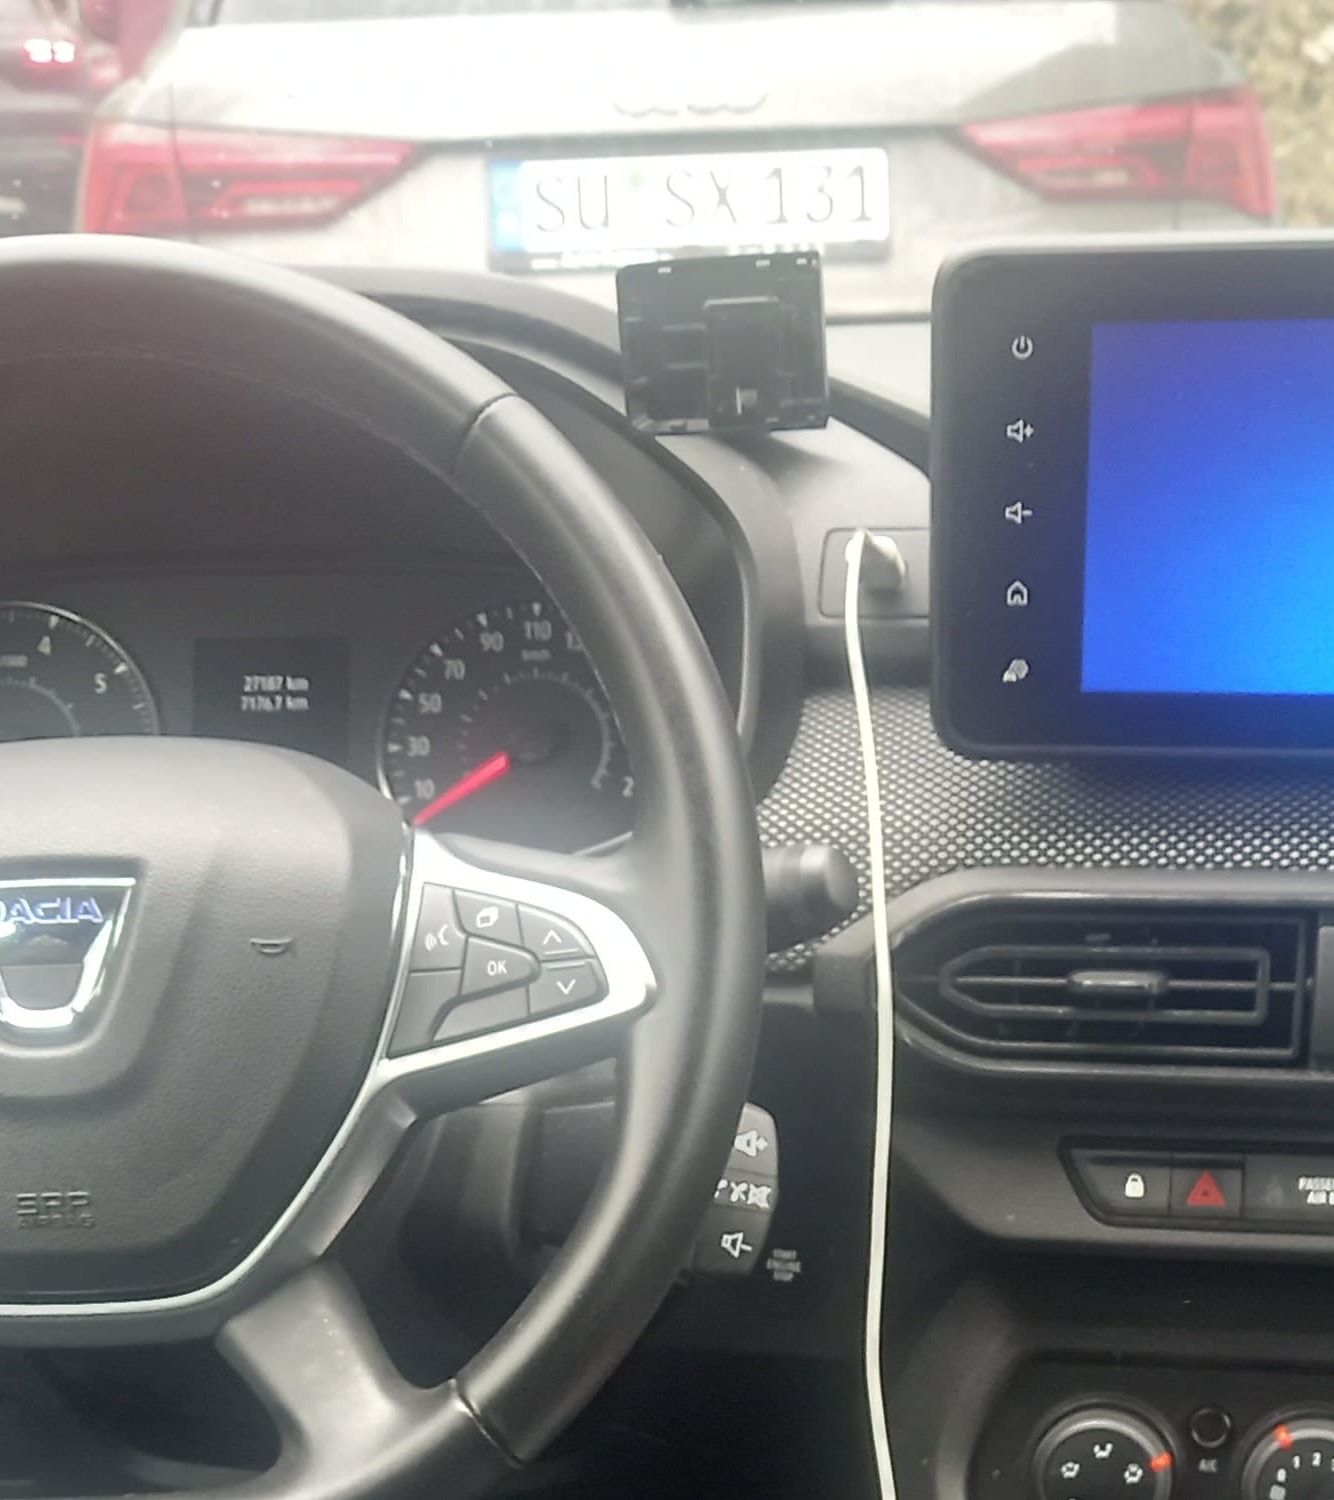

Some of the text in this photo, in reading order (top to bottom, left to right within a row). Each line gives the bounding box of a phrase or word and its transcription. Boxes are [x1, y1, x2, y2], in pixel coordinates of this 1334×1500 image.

[534, 163, 873, 233] SU SX 131
[37, 635, 51, 655] 4
[479, 631, 504, 651] 90
[442, 659, 465, 681] 70
[93, 672, 107, 694] 5
[419, 692, 443, 713] 50
[487, 960, 508, 976] OK
[1292, 1454, 1302, 1470] 1
[1311, 1450, 1322, 1467] 2
